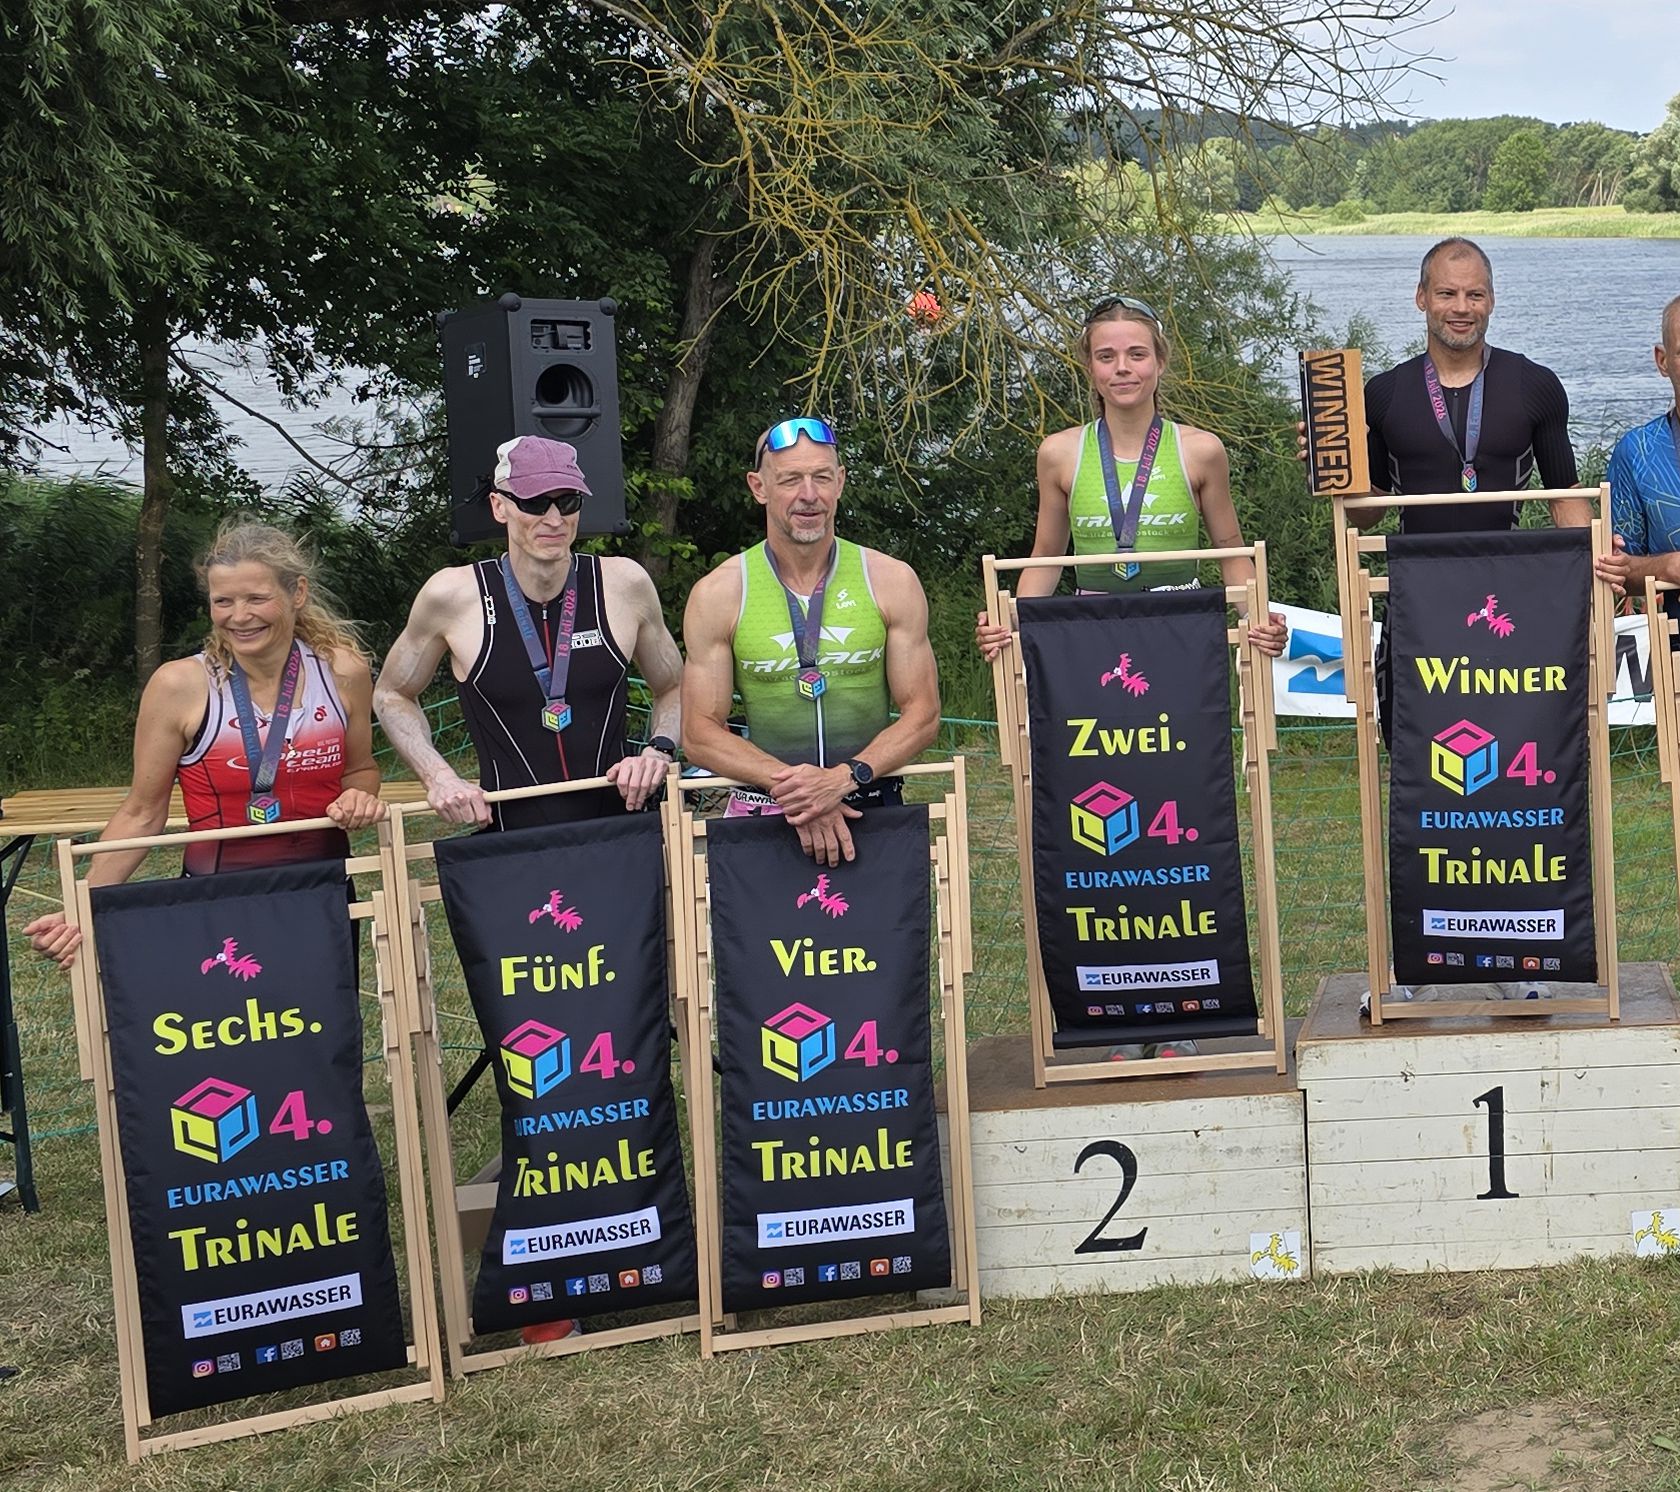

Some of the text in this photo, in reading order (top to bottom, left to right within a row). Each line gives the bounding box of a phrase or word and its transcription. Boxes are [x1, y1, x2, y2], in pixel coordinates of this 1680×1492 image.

[1311, 353, 1352, 491] WINNER
[564, 588, 576, 616] 2026
[1507, 742, 1556, 786] 4.
[1148, 800, 1199, 845] 4.
[1421, 808, 1565, 830] EURAWASSER
[1065, 864, 1211, 889] EURAWASSER
[1446, 916, 1557, 934] EURAWASSER
[1101, 966, 1211, 986] EURAWASSER
[580, 1032, 635, 1079] 4.
[844, 1020, 899, 1067] 4.
[269, 1091, 332, 1141] 4.
[752, 1088, 909, 1121] EURAWASSER
[1472, 1086, 1520, 1200] 1
[168, 1159, 349, 1208] EURAWASSER
[1073, 1140, 1149, 1255] 2
[527, 1218, 652, 1254] EURAWASSER
[784, 1210, 905, 1238] EURAWASSER
[215, 1283, 352, 1325] EURAWASSER
